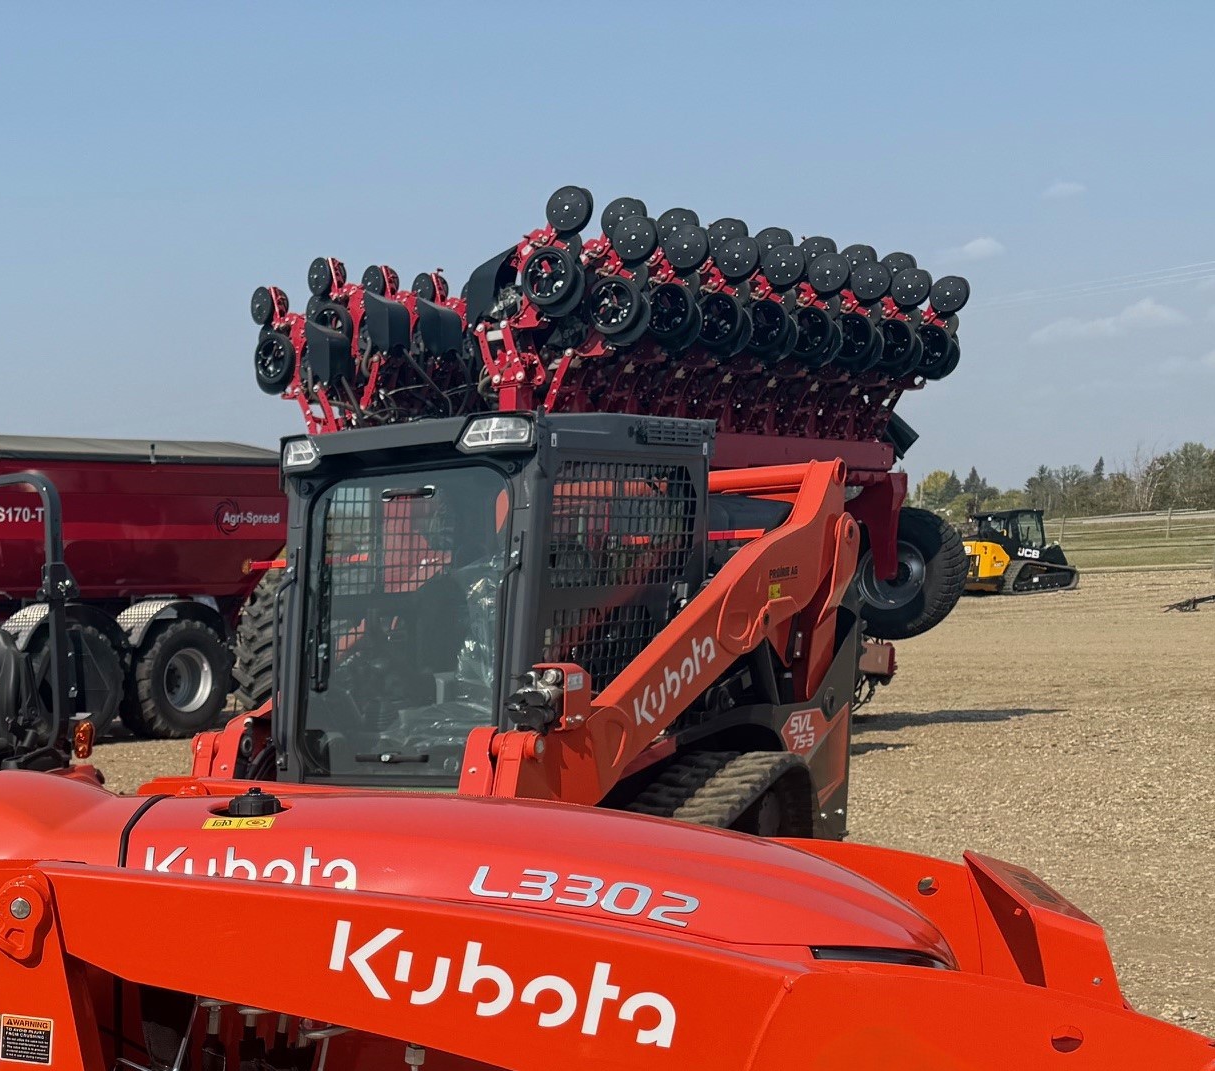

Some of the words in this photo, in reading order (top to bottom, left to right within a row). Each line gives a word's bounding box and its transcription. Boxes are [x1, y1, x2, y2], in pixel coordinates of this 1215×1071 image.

[222, 511, 281, 527] Agri-Spread
[1017, 547, 1040, 559] JCB
[633, 635, 716, 726] Kubota
[788, 713, 815, 735] SVL
[792, 732, 816, 750] 75-3
[144, 846, 358, 891] Kubota
[468, 865, 701, 928] L3302
[328, 919, 677, 1049] Kubota
[13, 1018, 49, 1029] WARNING
